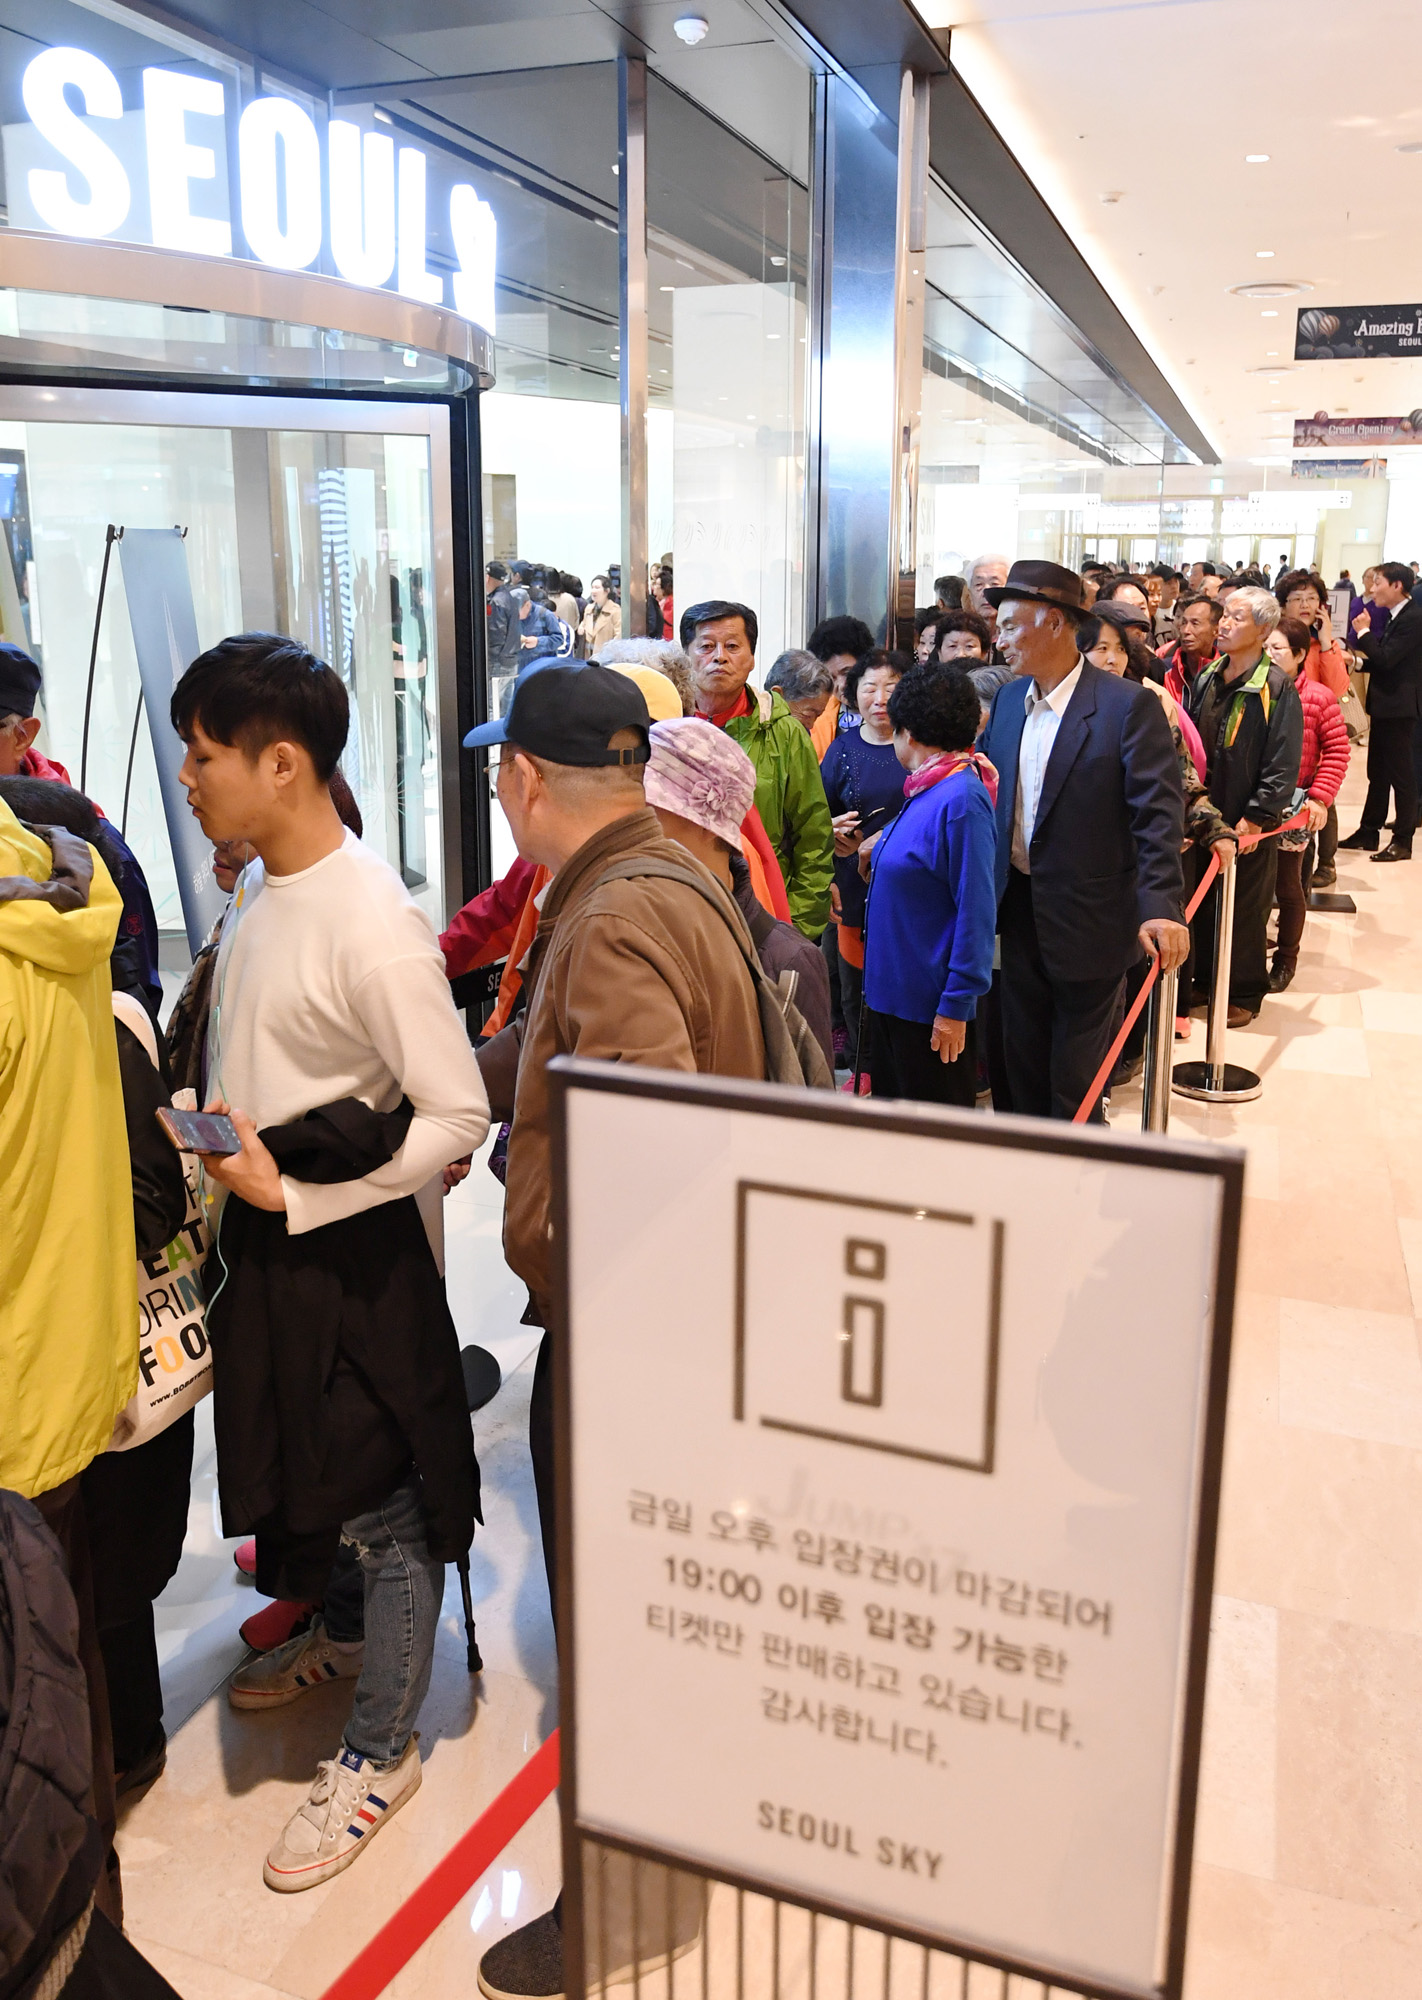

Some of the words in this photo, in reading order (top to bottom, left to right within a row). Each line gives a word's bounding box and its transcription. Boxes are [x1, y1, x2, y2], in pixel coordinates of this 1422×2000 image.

[21, 46, 443, 303] SEOUL
[1353, 319, 1413, 336] Amazing
[1398, 337, 1422, 347] SEOUL
[1328, 424, 1355, 435] Grand
[1357, 424, 1394, 436] Opening
[487, 971, 501, 992] SE
[138, 1269, 206, 1338] DRIN
[138, 1322, 207, 1387] FOO
[628, 1489, 692, 1535] 금일
[708, 1510, 778, 1552] 오후
[793, 1528, 940, 1595] 입장권이
[955, 1570, 1113, 1637] 마감되어
[664, 1555, 763, 1605] 19:00
[777, 1583, 846, 1626] 이후
[864, 1603, 936, 1650] 입장
[953, 1626, 1069, 1685] 가능한
[646, 1603, 745, 1657] 티켓만
[761, 1631, 902, 1696] 판매하고
[919, 1673, 1083, 1749] 있습니다.
[762, 1686, 949, 1769] 감사합니다.
[758, 1800, 859, 1857] SEOUL
[877, 1835, 943, 1880] SKY
